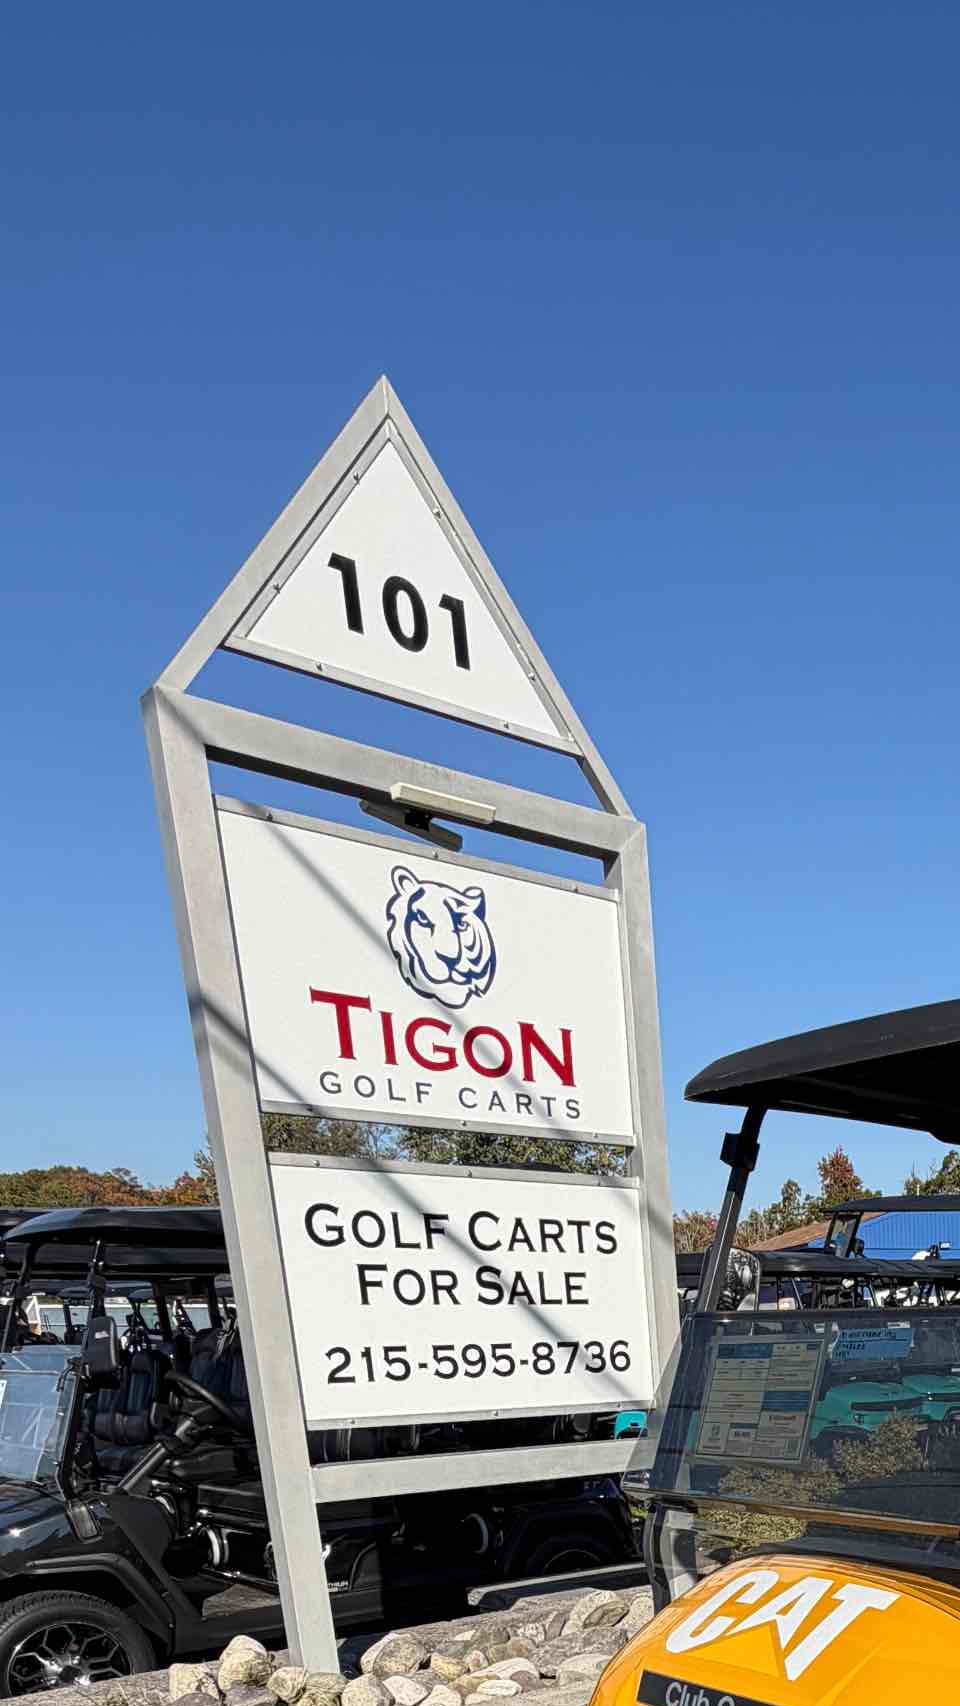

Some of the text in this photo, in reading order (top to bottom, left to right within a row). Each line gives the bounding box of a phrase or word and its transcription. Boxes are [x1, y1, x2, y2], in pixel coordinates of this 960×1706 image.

[327, 552, 470, 671] 101
[308, 986, 577, 1088] TIGON
[319, 1070, 581, 1120] GOLF CARTS
[304, 1202, 618, 1255] GOLF CARTS
[357, 1263, 590, 1306] FOR SALE
[325, 1339, 632, 1385] 215-595-8736
[665, 1570, 901, 1681] CAT
